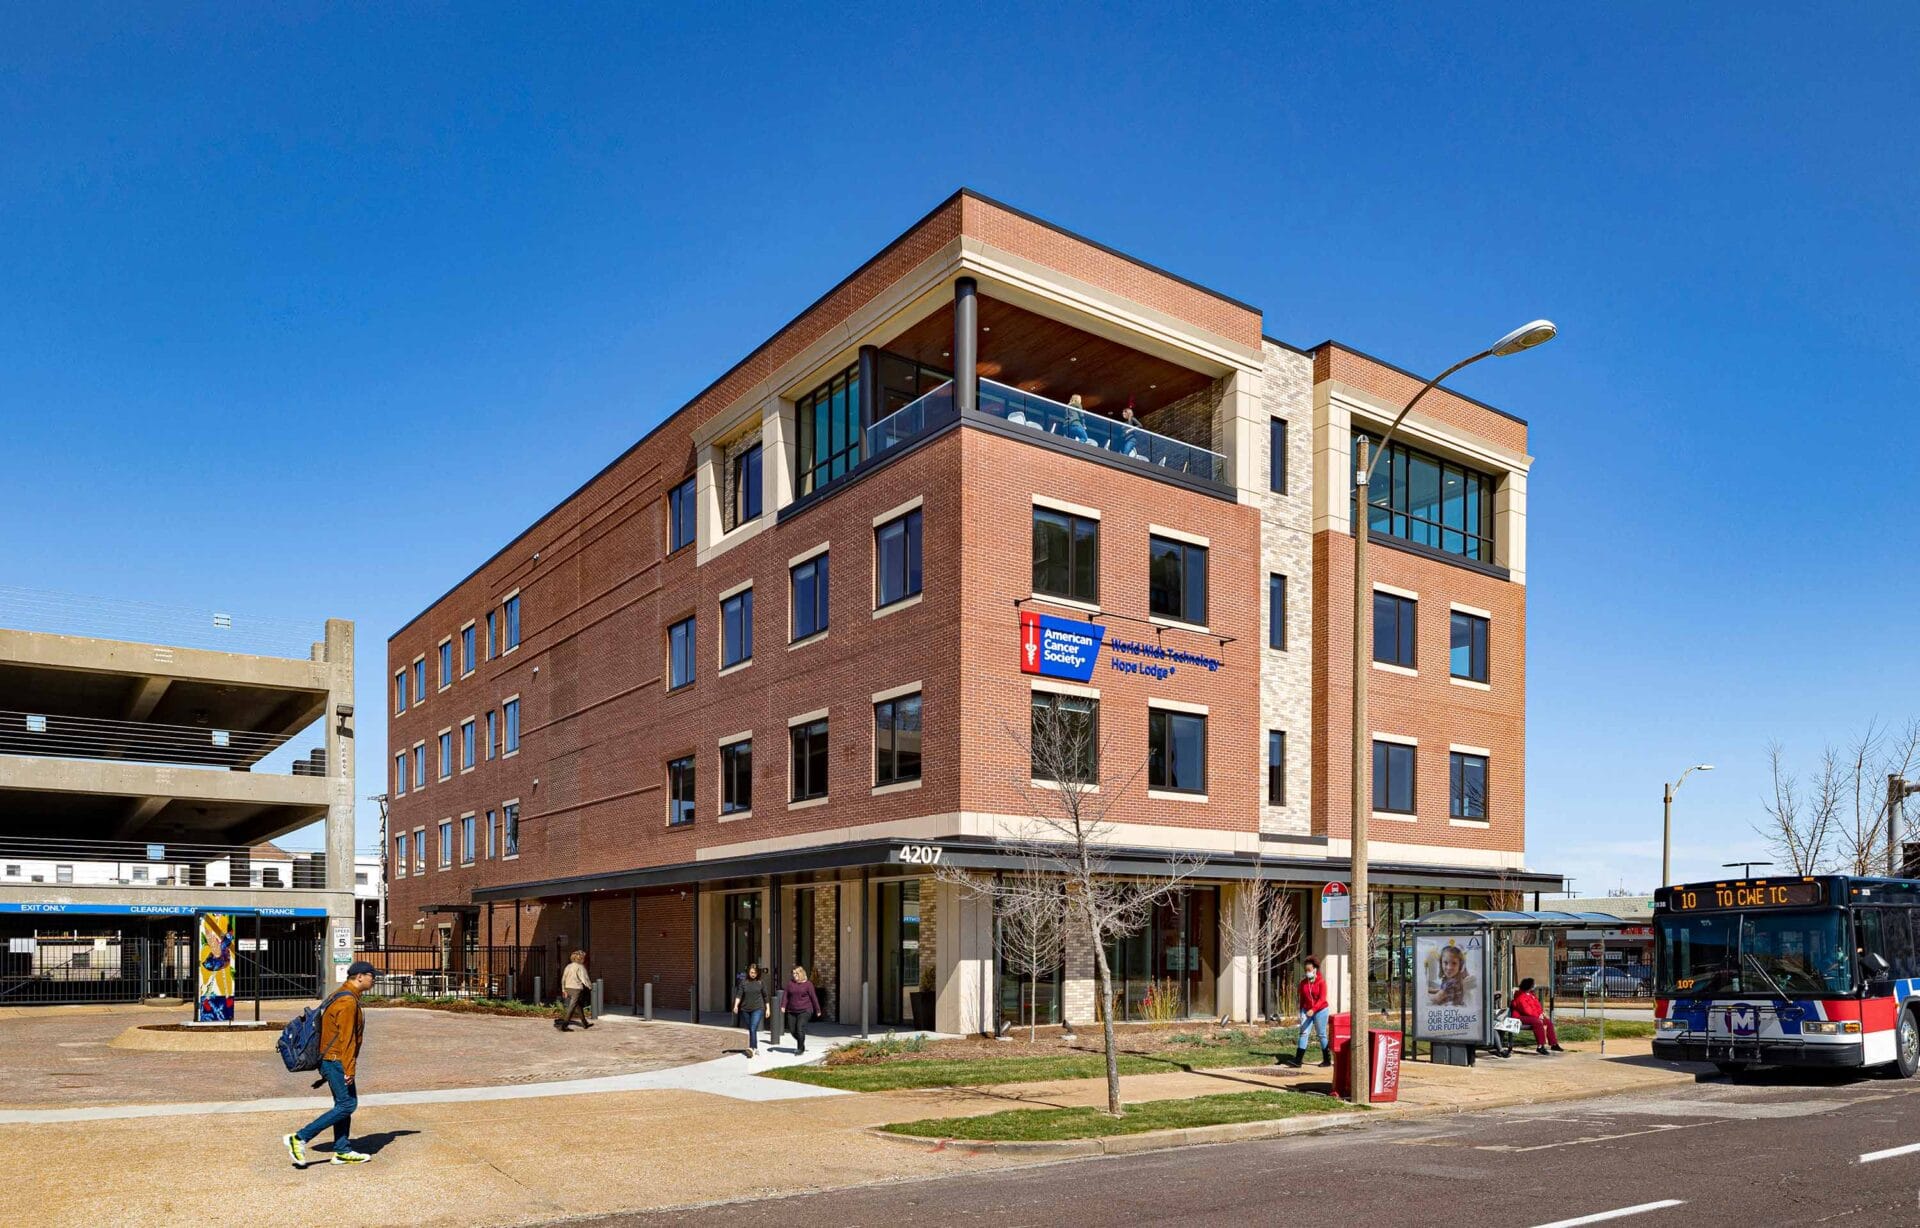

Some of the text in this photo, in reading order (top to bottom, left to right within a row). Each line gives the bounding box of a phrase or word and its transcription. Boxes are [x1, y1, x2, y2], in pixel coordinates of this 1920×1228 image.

[1044, 628, 1093, 646] American
[1044, 639, 1079, 654] Cancer
[1111, 638, 1220, 672] World Wide Technology
[1111, 657, 1168, 680] Hope Lodge
[899, 845, 943, 864] 4207
[1681, 886, 1788, 909] 10 TO CWE TC
[21, 904, 66, 912] EXIT ONLY
[130, 906, 180, 914] CLEARANCE
[338, 938, 347, 947] 5
[1428, 1010, 1442, 1018] OUR
[1384, 1036, 1400, 1088] AMERICAN
